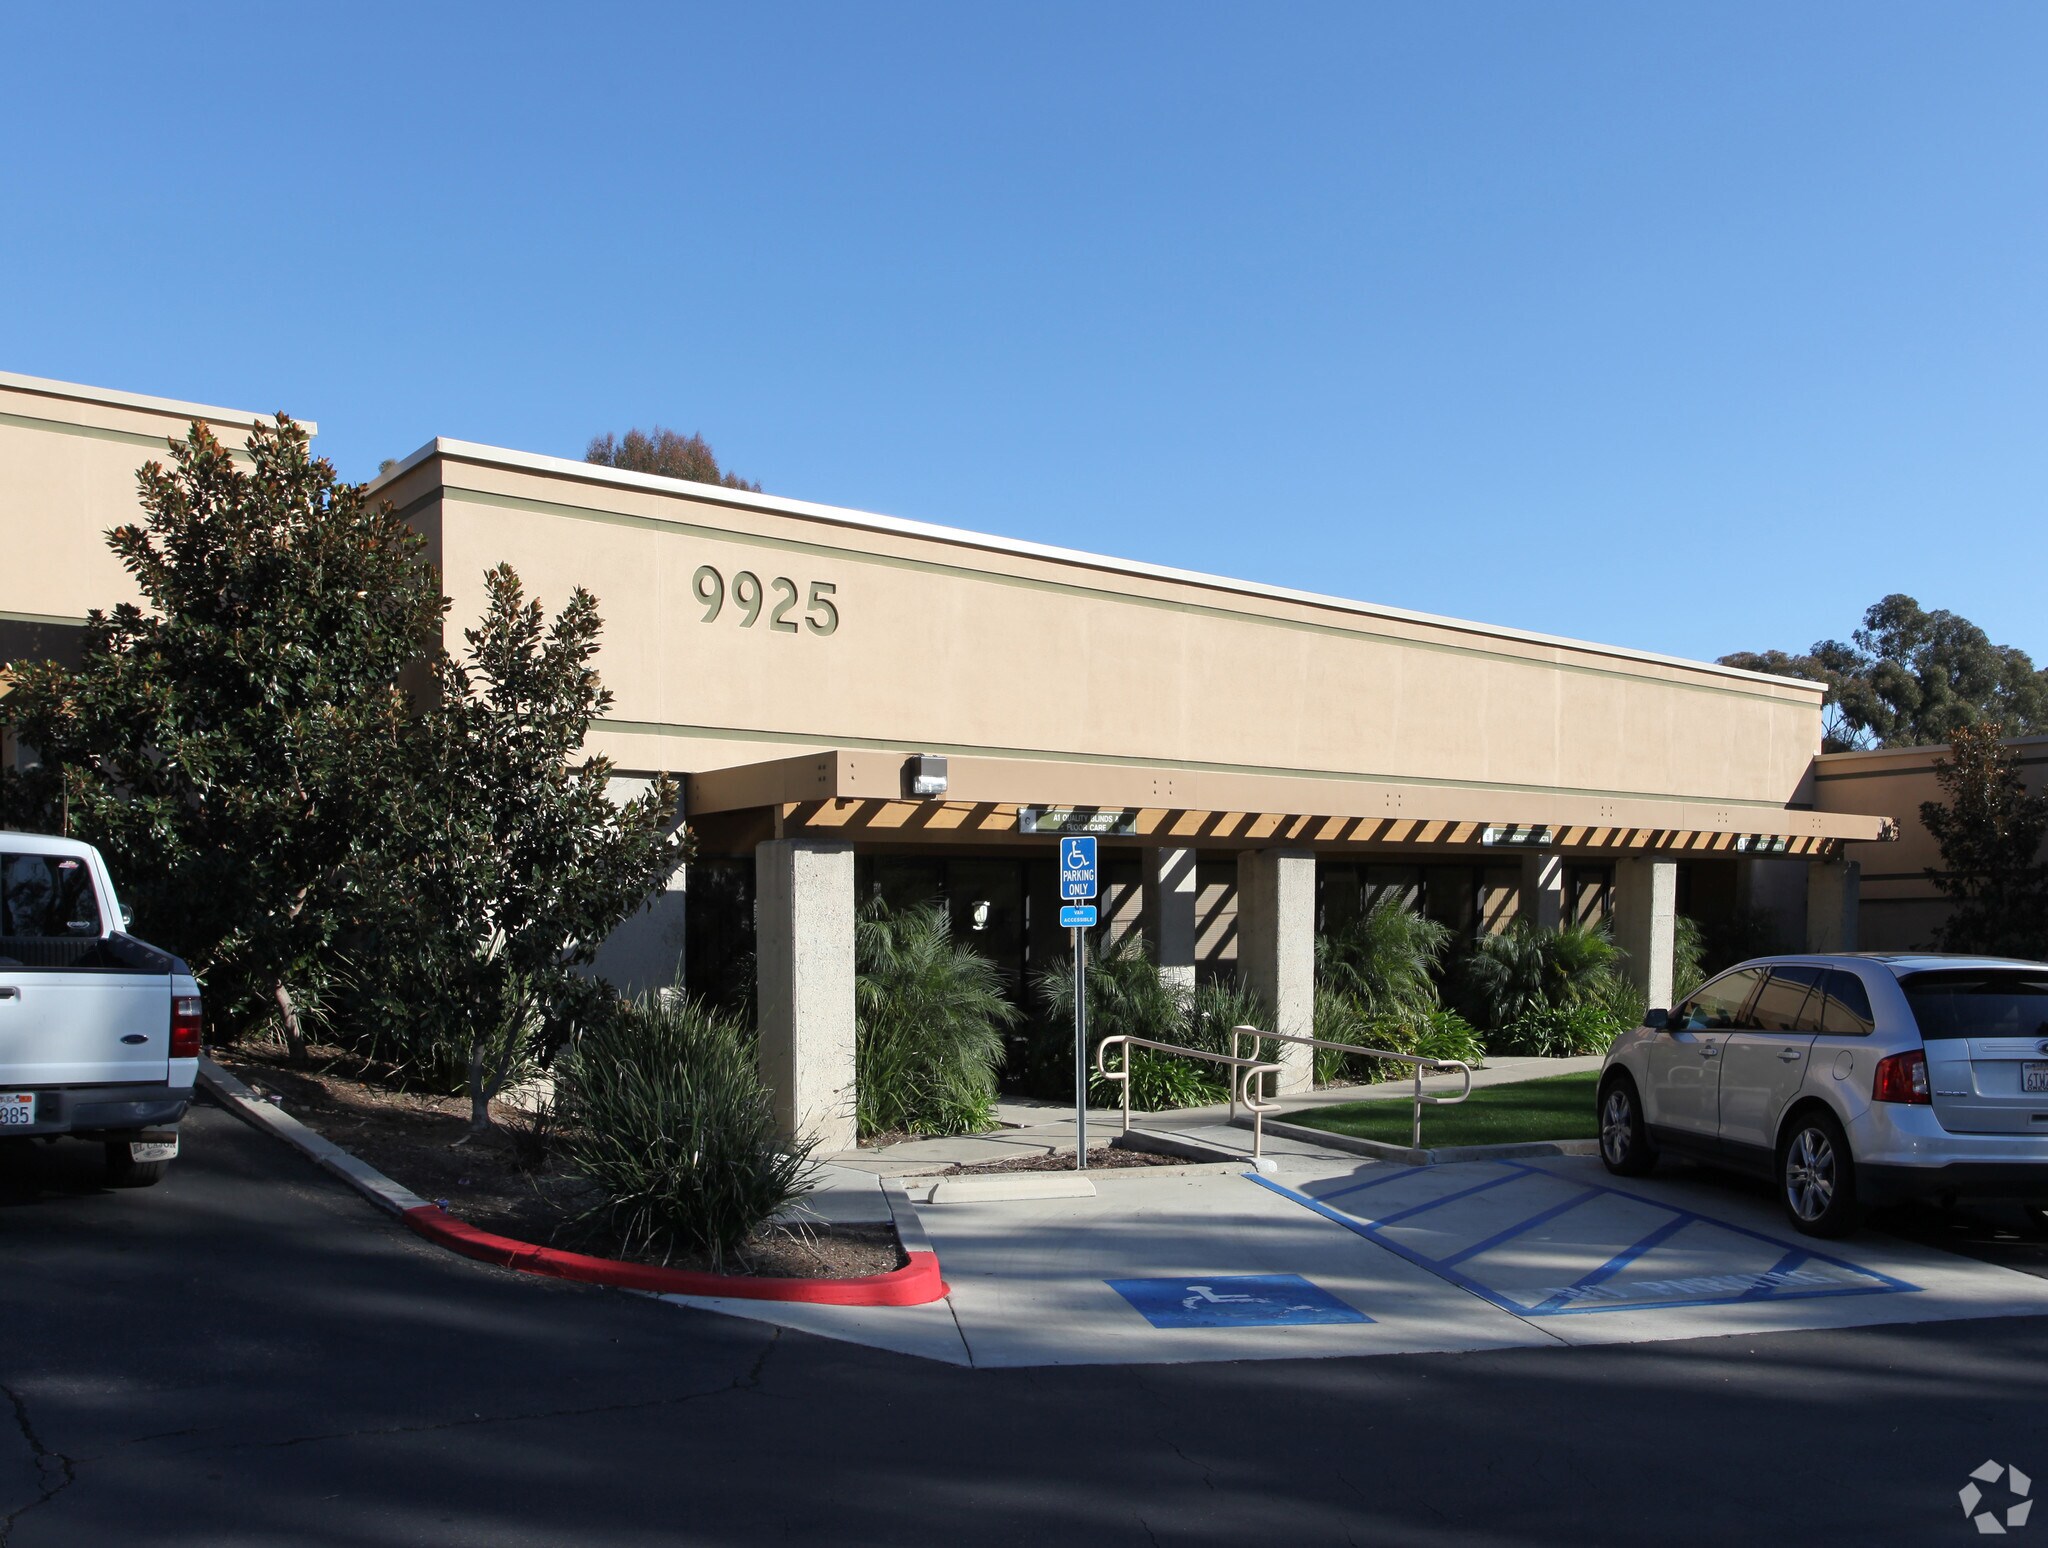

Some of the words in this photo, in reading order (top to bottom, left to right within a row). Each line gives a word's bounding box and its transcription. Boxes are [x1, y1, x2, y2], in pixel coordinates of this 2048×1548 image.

[692, 564, 839, 636] 9925
[1053, 814, 1061, 822] A1
[1062, 814, 1088, 822] QUALITY
[1090, 815, 1113, 823] BLINDS
[1067, 823, 1088, 831] FLOOR
[1089, 824, 1107, 832] CARE
[1063, 869, 1094, 882] PARKING
[1069, 883, 1088, 896] ONLY
